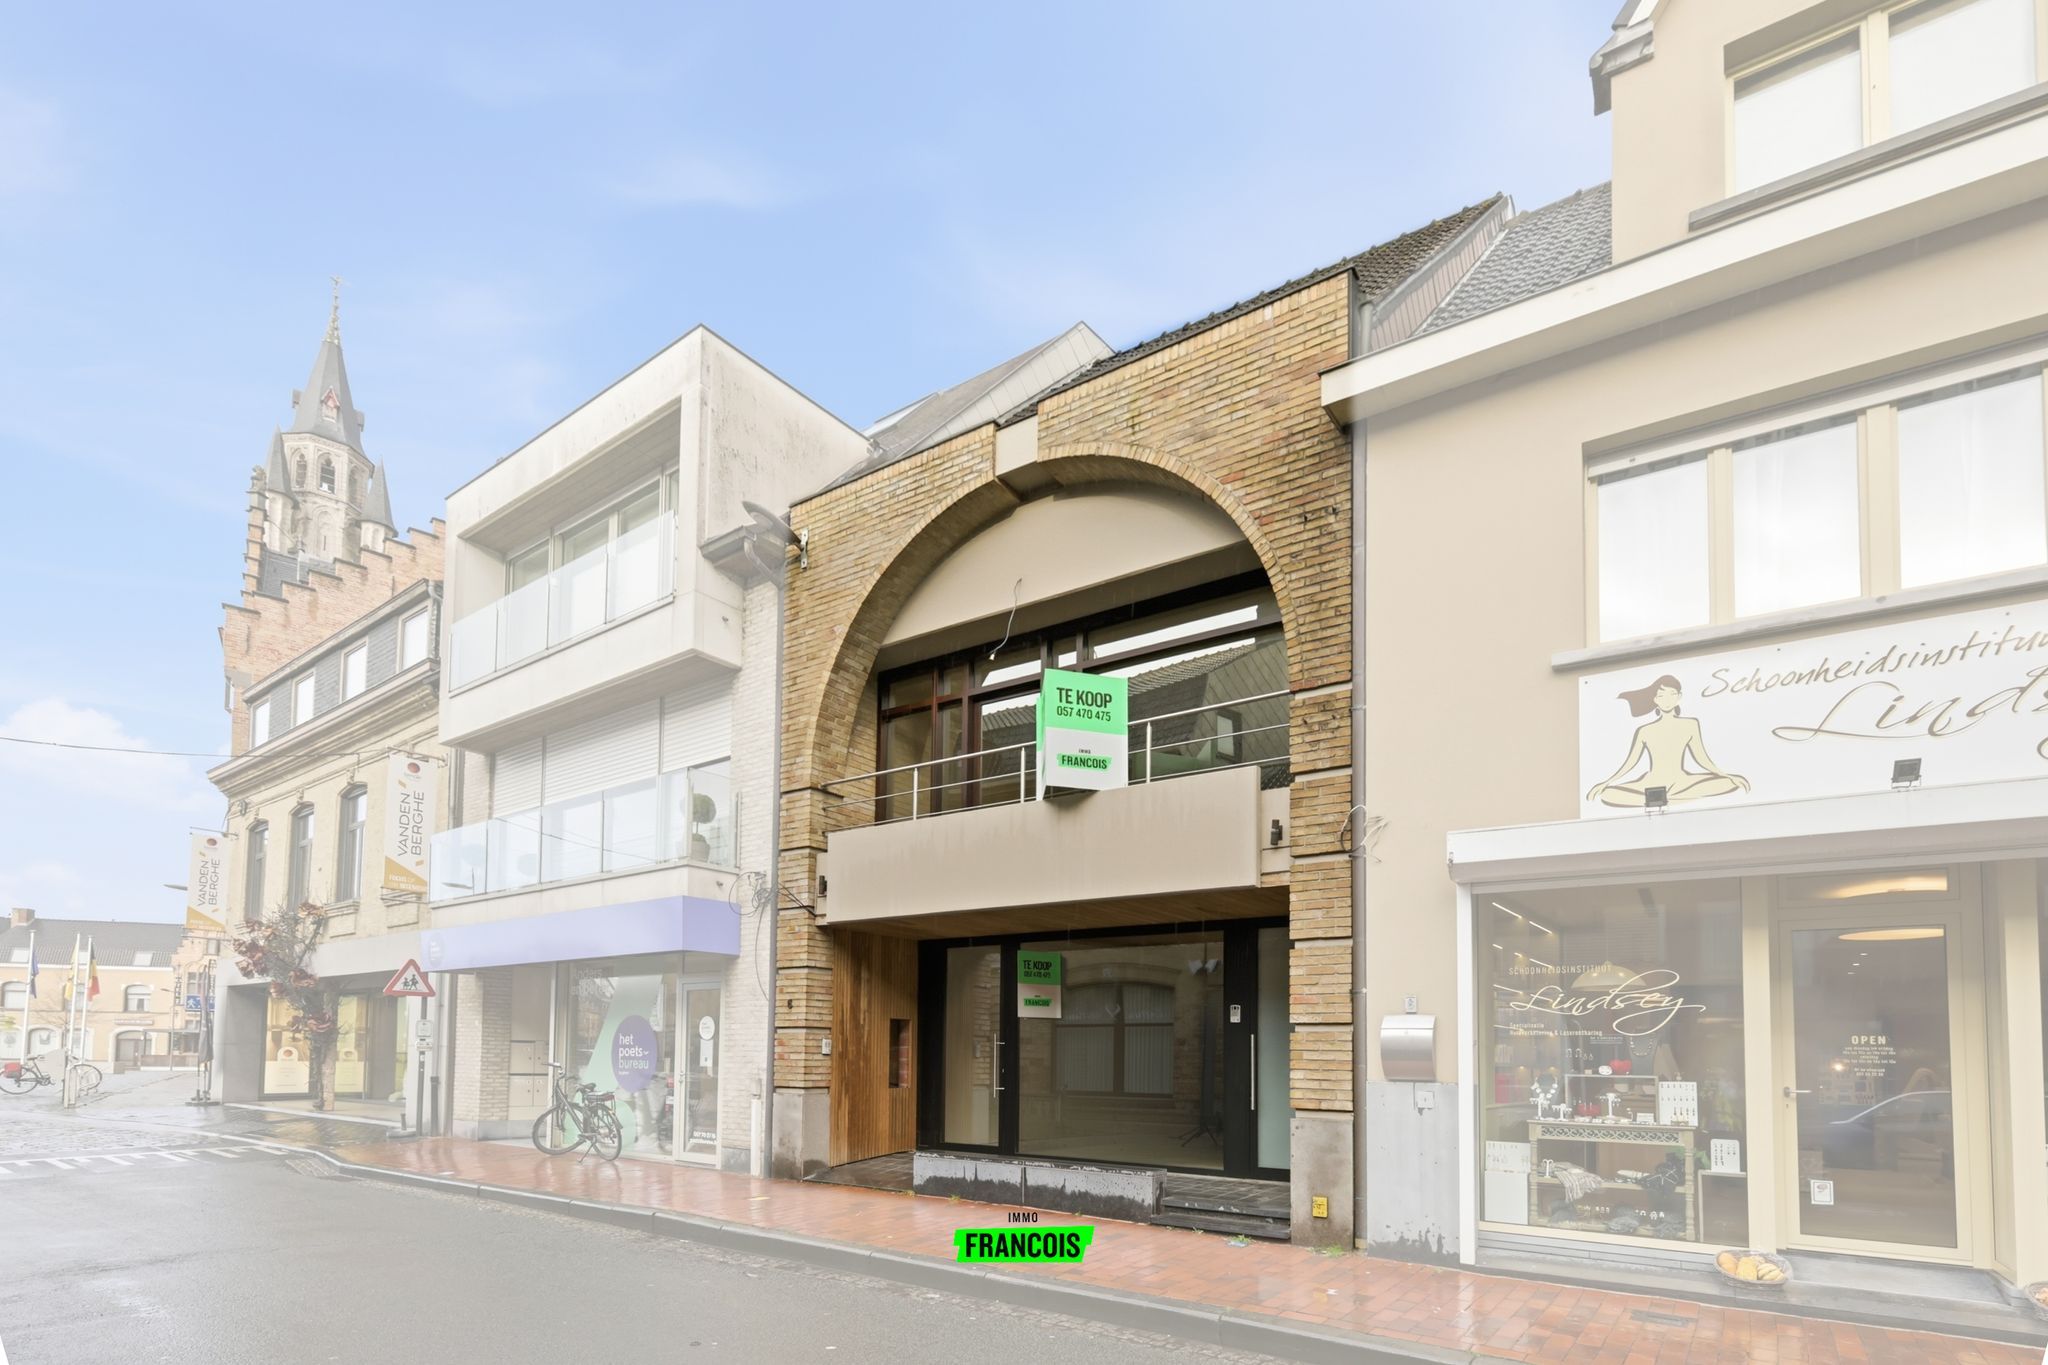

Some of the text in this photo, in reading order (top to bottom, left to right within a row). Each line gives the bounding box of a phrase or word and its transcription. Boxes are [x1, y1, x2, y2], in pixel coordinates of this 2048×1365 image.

[1056, 687, 1112, 708] TE KOOP
[1056, 705, 1111, 722] 057 470 475
[1061, 755, 1107, 770] FRANCOIS
[397, 792, 410, 857] VANDEN
[411, 790, 425, 856] BERGHE
[198, 860, 209, 906] VANDEN
[209, 858, 220, 905] BERGHE
[1023, 959, 1052, 971] TE KOOP
[1509, 969, 1706, 1036] Lindsey
[619, 1033, 633, 1045] het
[1851, 1035, 1886, 1045] OPEN
[618, 1046, 643, 1058] poets
[618, 1058, 649, 1069] bureau
